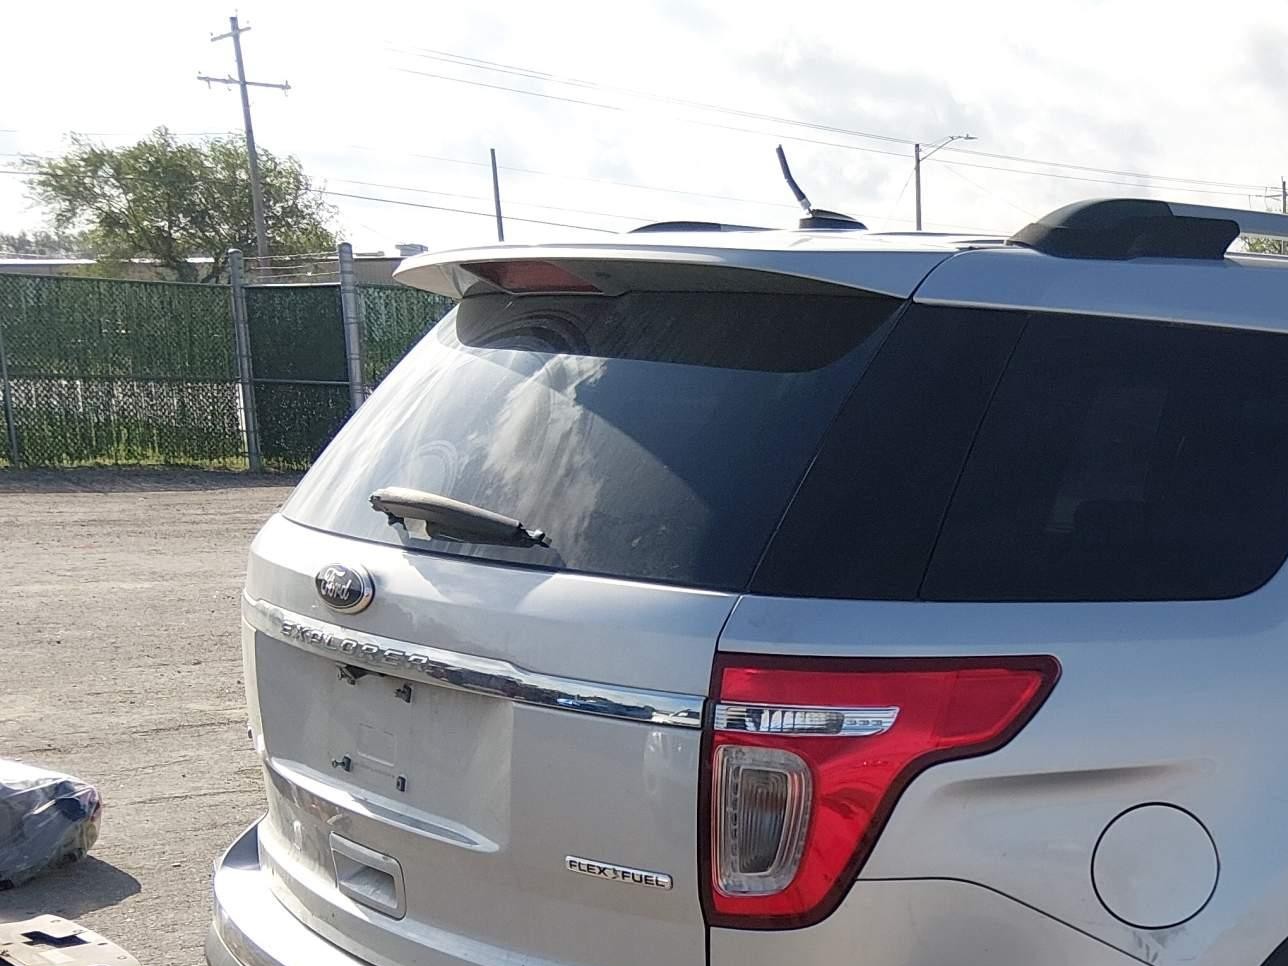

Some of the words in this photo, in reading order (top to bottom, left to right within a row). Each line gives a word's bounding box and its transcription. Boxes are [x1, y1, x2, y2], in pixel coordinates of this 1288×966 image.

[320, 567, 352, 600] Ford
[280, 619, 430, 672] EXPLORER
[569, 860, 608, 877] FLEX
[621, 871, 666, 888] FUEL
